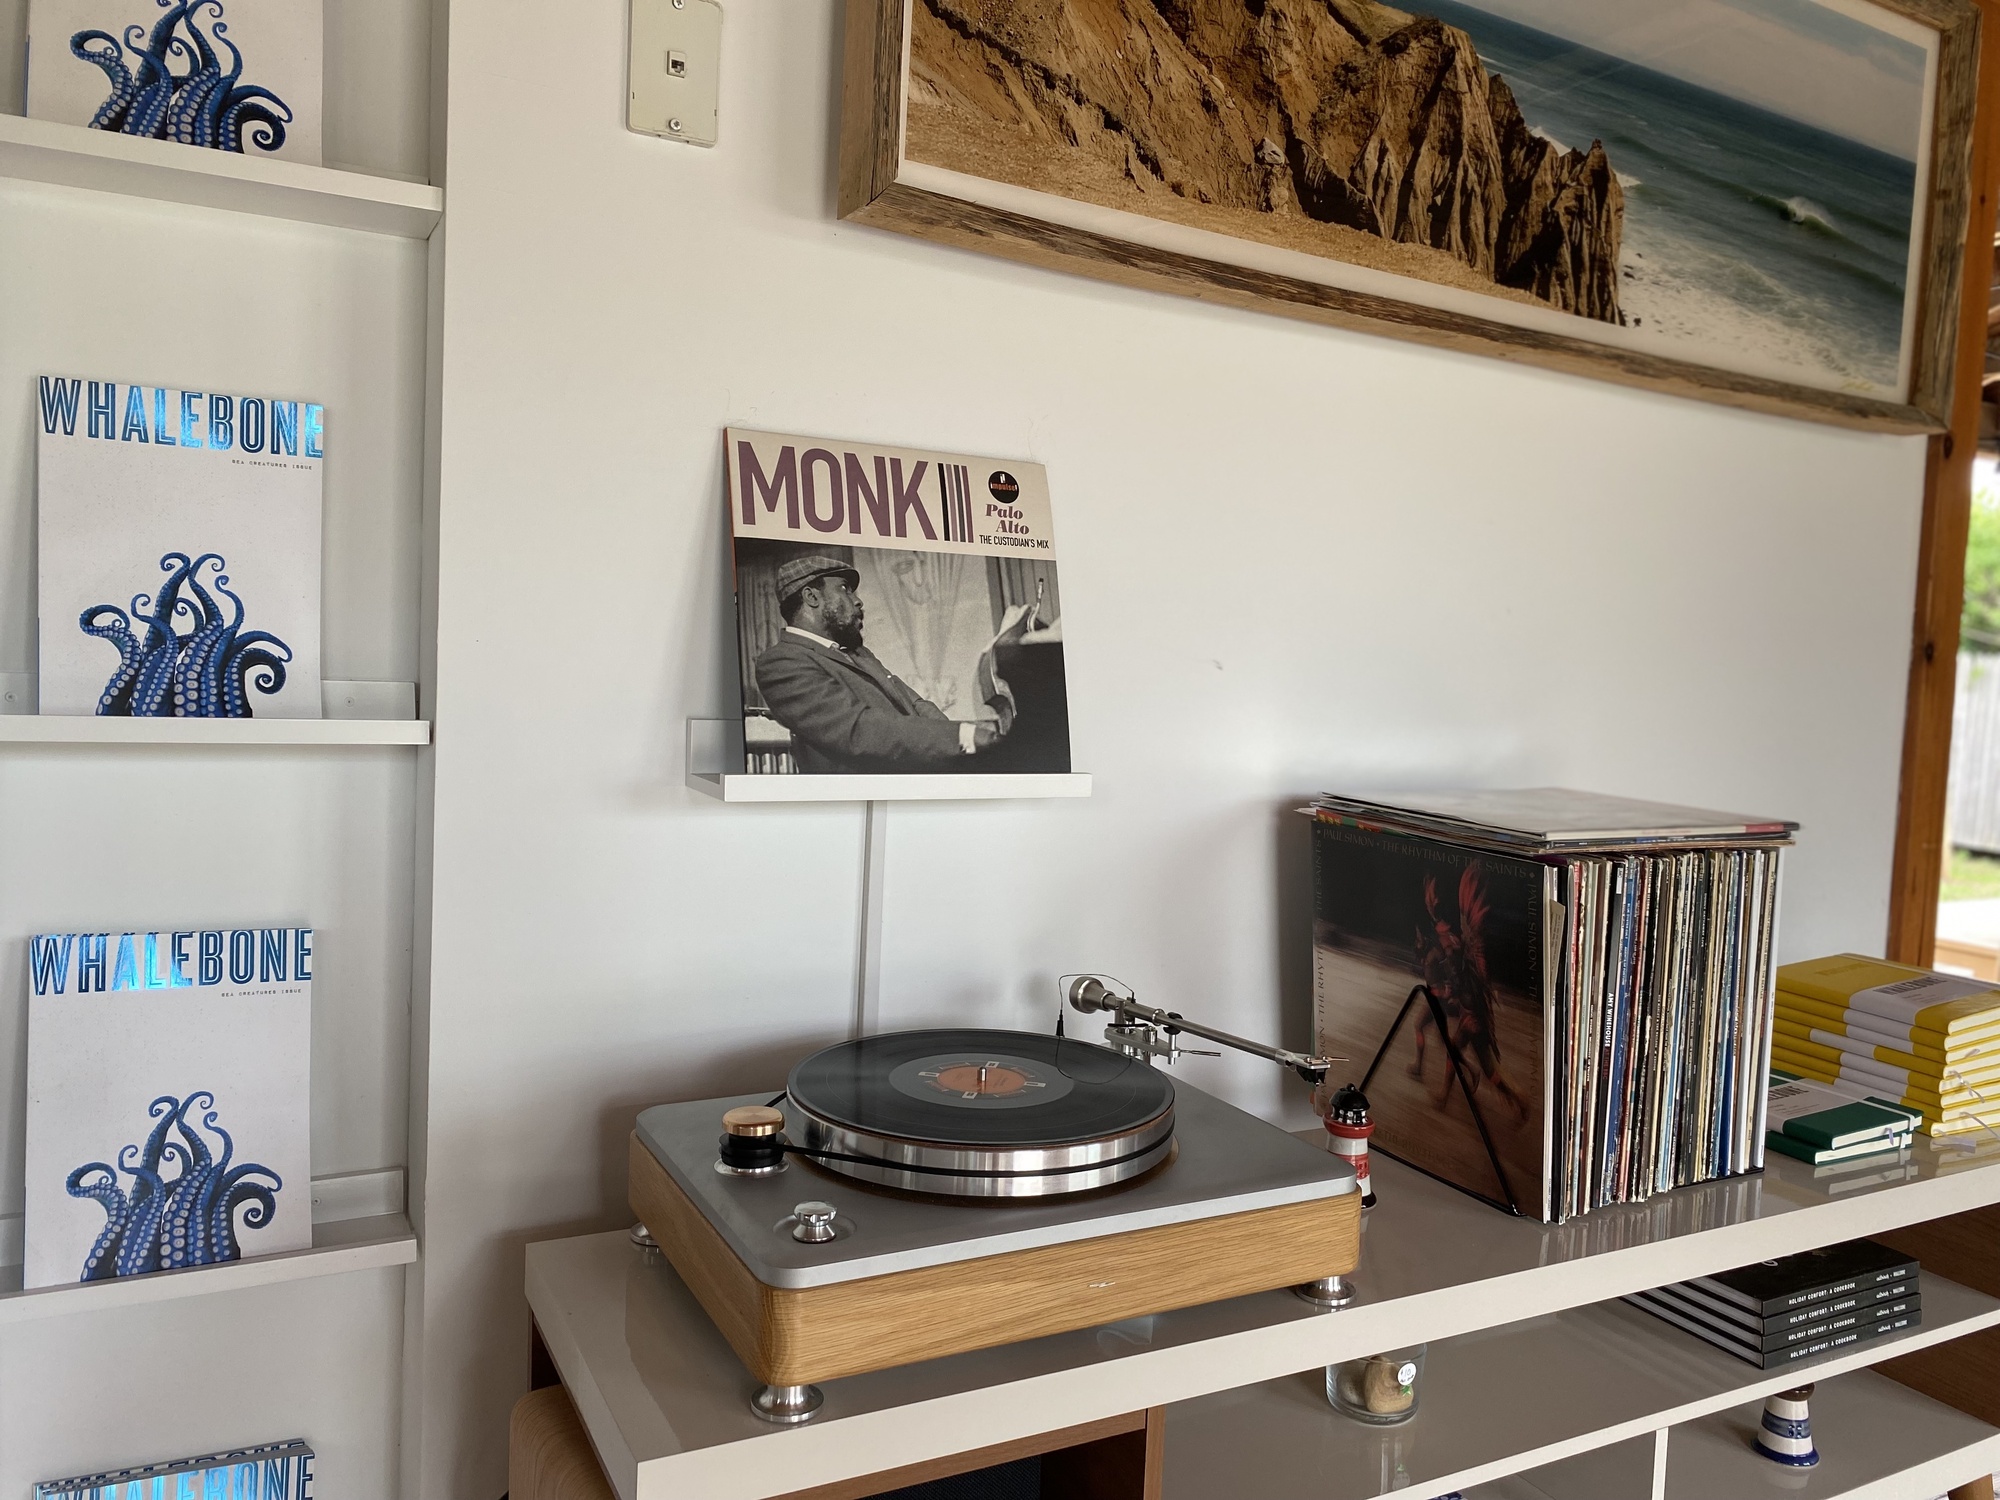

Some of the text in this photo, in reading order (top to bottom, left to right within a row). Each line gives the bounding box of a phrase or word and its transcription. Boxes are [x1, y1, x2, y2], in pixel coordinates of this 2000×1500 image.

[40, 376, 324, 458] WHALEBONE
[737, 440, 938, 541] MONK
[986, 504, 1024, 520] Palo
[996, 520, 1030, 534] Alto
[979, 534, 1050, 550] THE CUSTODIAN'S MIX
[1323, 828, 1343, 841] PAUL
[1344, 833, 1374, 848] SIMON
[1382, 840, 1400, 854] THE
[1401, 844, 1446, 864] RHYTHM
[1448, 854, 1460, 867] OF
[1486, 861, 1527, 879] SAINTS
[1528, 922, 1537, 971] SIMON
[30, 928, 312, 996] WHALEBONE
[1604, 1008, 1612, 1047] WINEHOUSE
[1789, 1296, 1806, 1305] HOLIDAY
[1834, 1282, 1855, 1292] COOKBOOK
[1790, 1314, 1807, 1323] HOLIDAY
[1834, 1300, 1855, 1310] COOKBOOK
[1789, 1331, 1806, 1340] HOLIDAY
[1834, 1318, 1855, 1328] COOKBOOK
[1791, 1349, 1808, 1358] HOLIDAY
[1835, 1334, 1857, 1345] COOKBOOK
